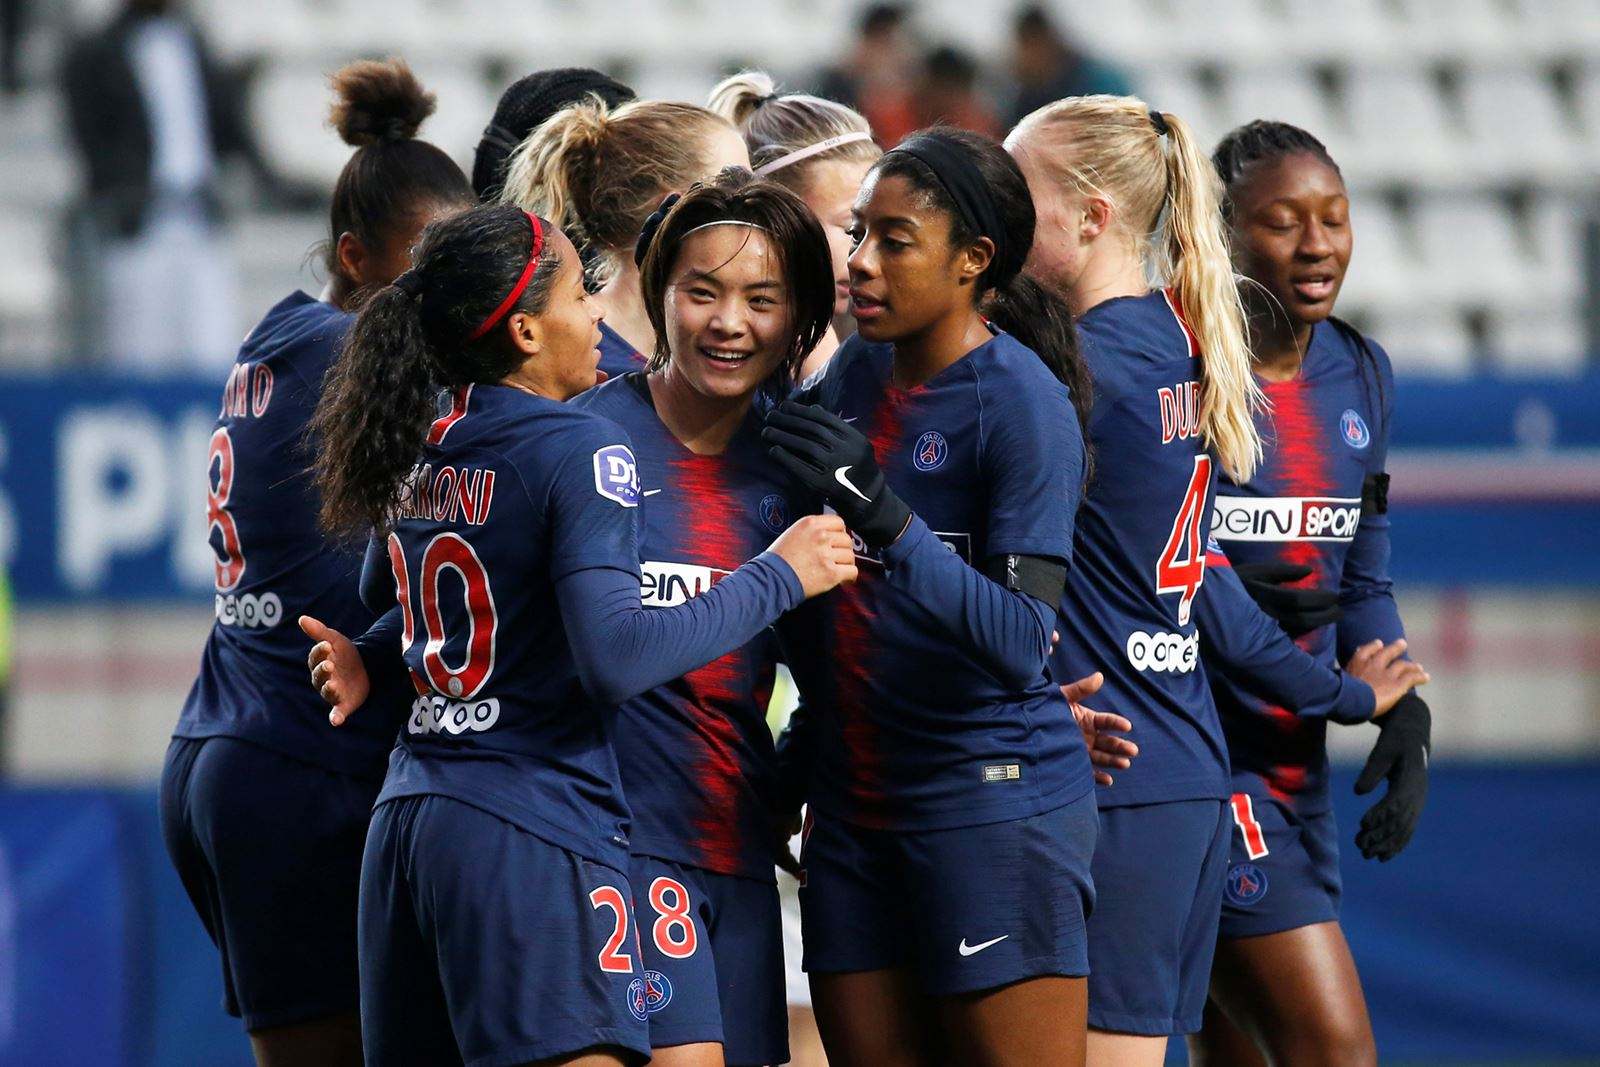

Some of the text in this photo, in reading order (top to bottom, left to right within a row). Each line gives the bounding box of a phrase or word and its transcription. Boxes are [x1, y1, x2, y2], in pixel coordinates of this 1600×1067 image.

[923, 433, 943, 446] PARIS
[207, 427, 246, 592] 8
[385, 463, 495, 525] RRONI
[1156, 454, 1212, 627] 4
[1126, 629, 1200, 673] oore
[589, 885, 644, 974] 2
[648, 876, 697, 959] 8
